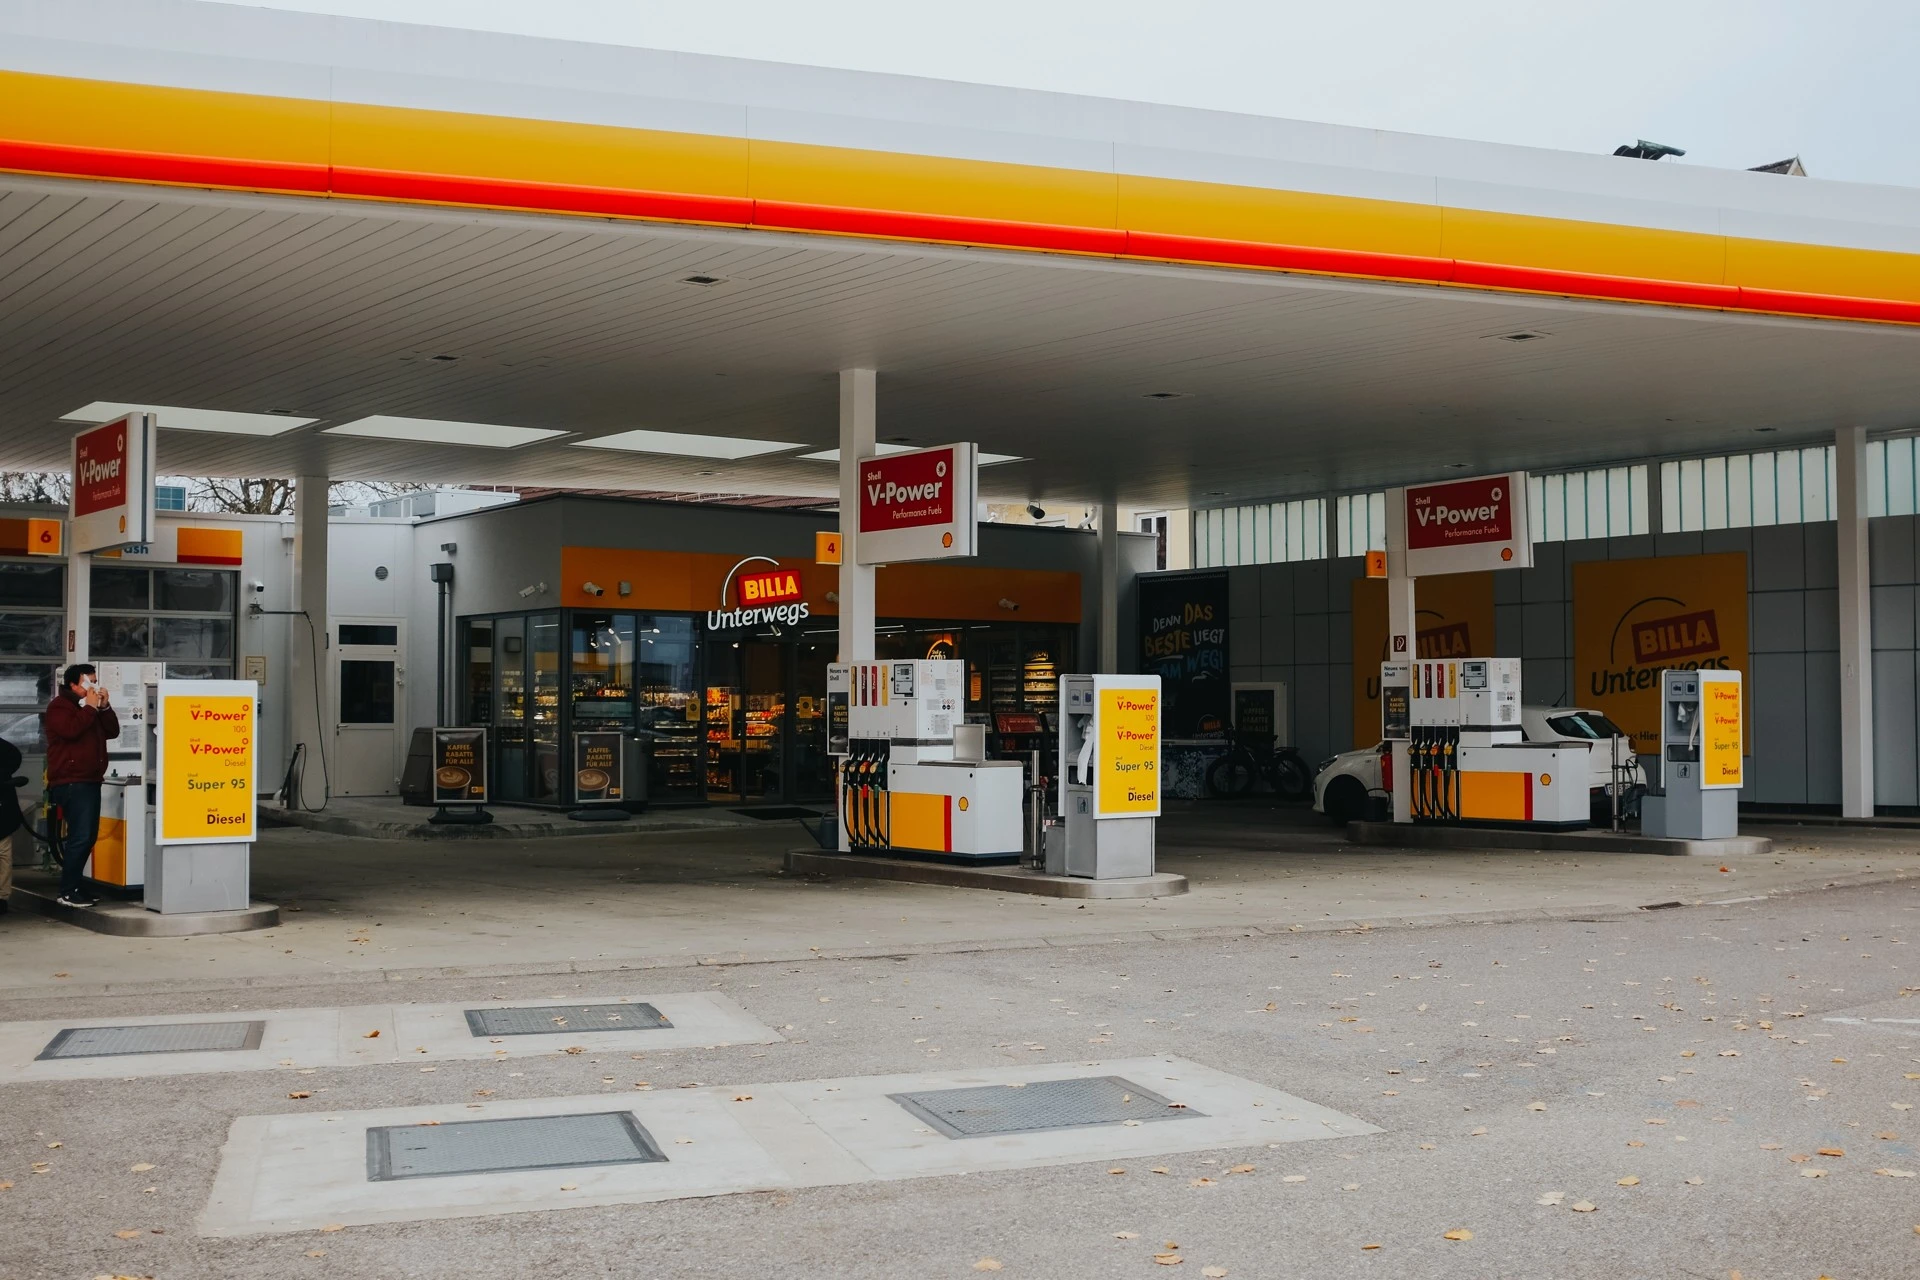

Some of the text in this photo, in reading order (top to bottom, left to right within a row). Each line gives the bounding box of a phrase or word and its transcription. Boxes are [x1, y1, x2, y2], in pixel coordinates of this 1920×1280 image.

[79, 458, 121, 487] V-Power
[867, 470, 882, 481] Shell
[867, 481, 943, 507] V-Power
[1415, 496, 1431, 506] Shell
[892, 504, 942, 519] Performance Fuels
[1415, 504, 1499, 527] V-Power
[40, 530, 52, 543] 6
[1444, 524, 1500, 538] Performance Fuels
[827, 542, 836, 554] 4
[1376, 559, 1383, 569] 2
[744, 575, 798, 600] BILLA
[707, 602, 809, 631] Unterwegs
[1153, 602, 1213, 633] DENN DAS
[1144, 629, 1225, 658] BESTE LIEGT
[1638, 620, 1713, 656] BILLA
[1416, 630, 1467, 659] ILLA
[1714, 692, 1737, 700] V-Power
[1117, 701, 1154, 711] V-Power
[191, 710, 247, 721] V-Power
[233, 725, 246, 733] 100
[1117, 731, 1154, 740] V-Power
[1640, 731, 1659, 741] Hier
[190, 744, 246, 755] V-Power
[1714, 741, 1739, 751] Super 95
[224, 759, 246, 767] Diesel
[1115, 761, 1154, 772] Super 95
[1722, 767, 1739, 775] Diesel
[187, 778, 246, 792] Super 95
[1128, 791, 1154, 801] Diesel
[207, 813, 246, 825] Diesel
